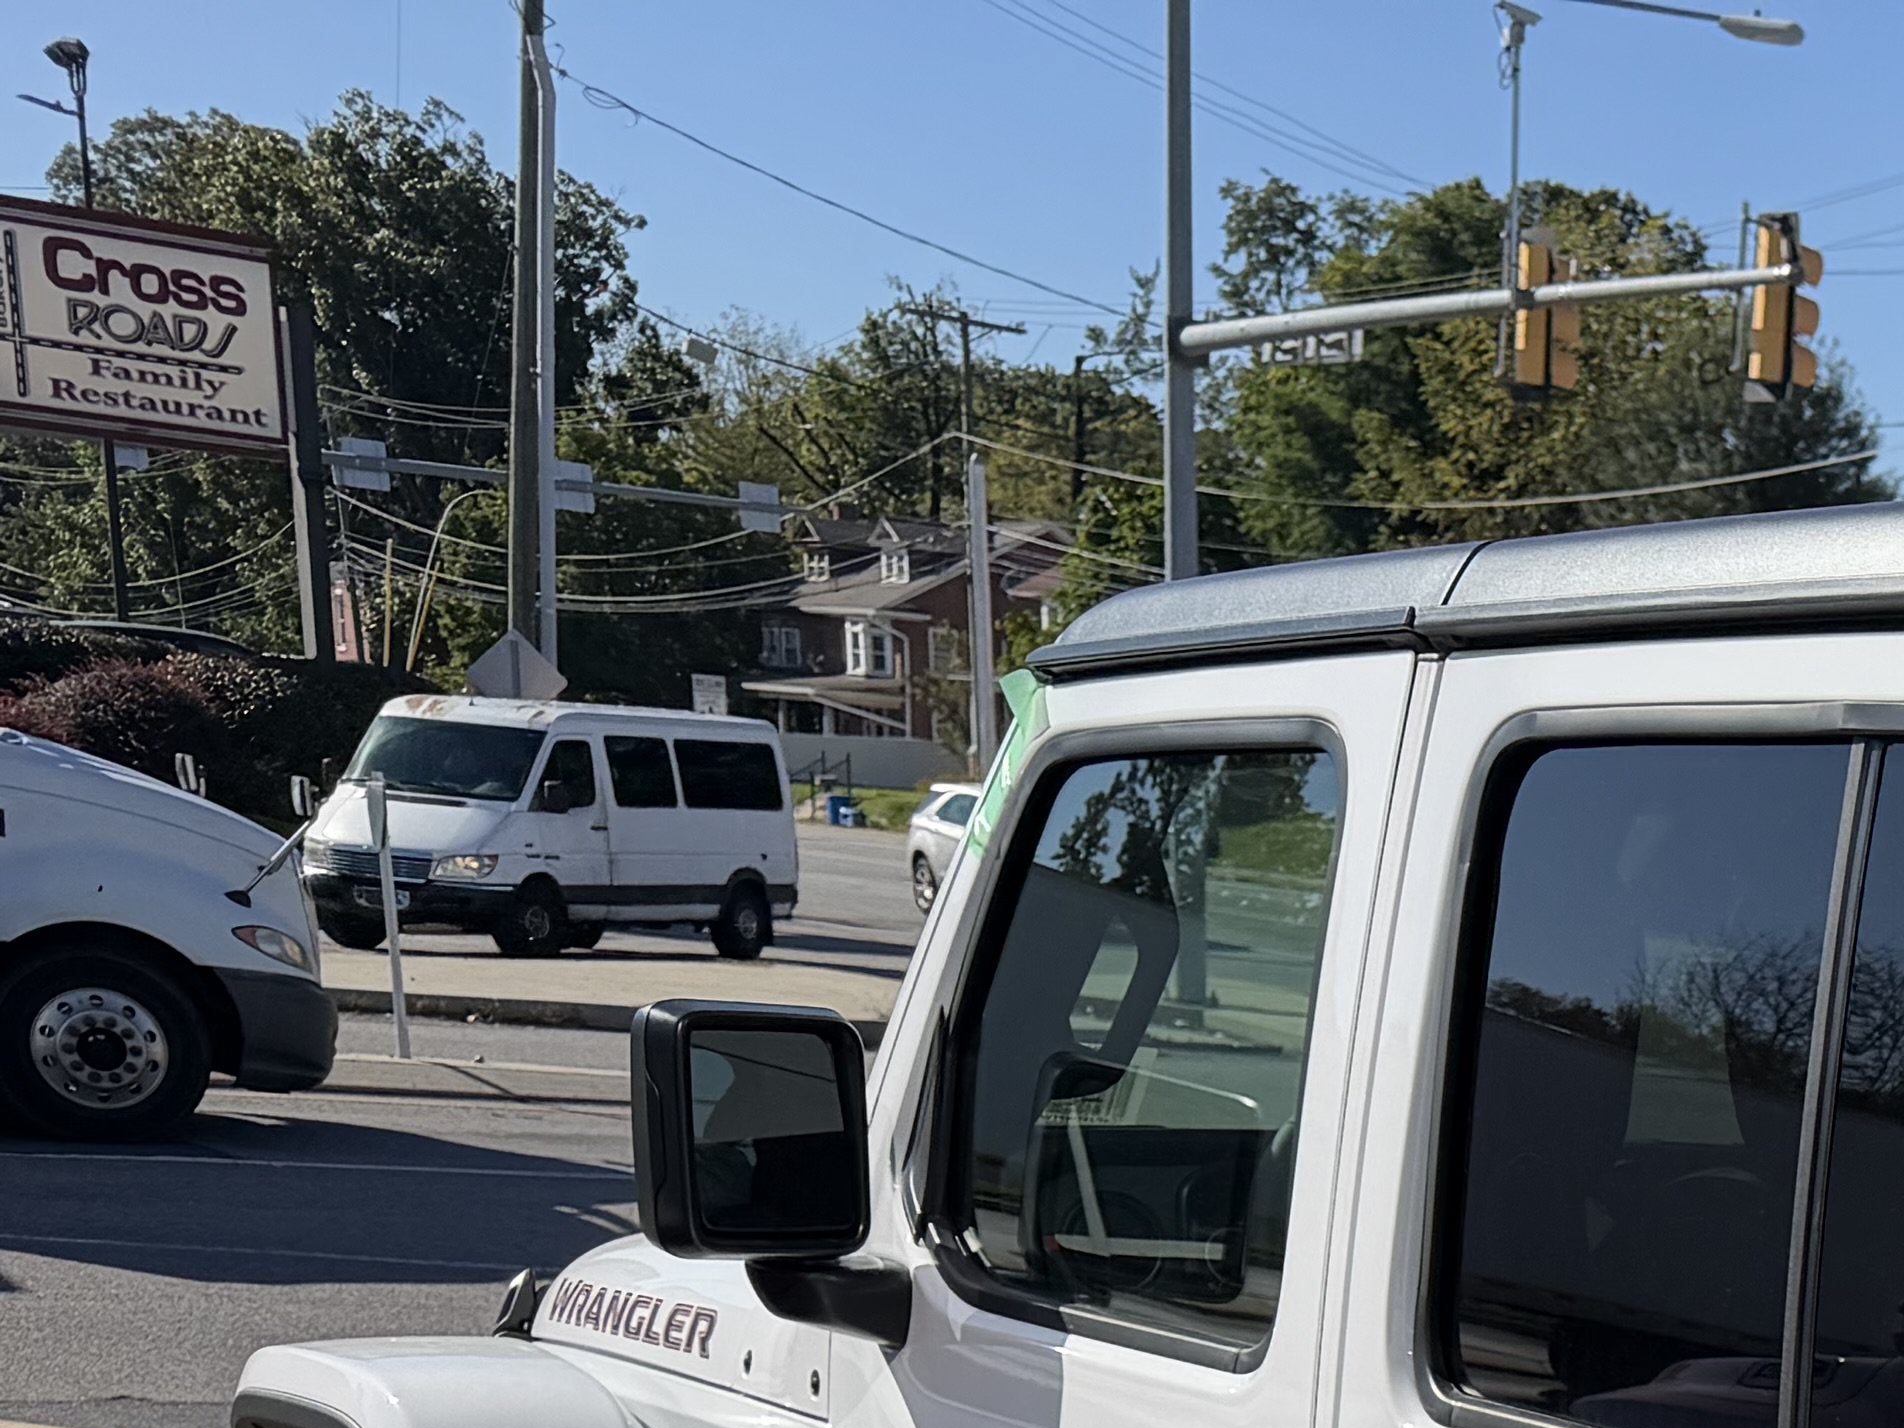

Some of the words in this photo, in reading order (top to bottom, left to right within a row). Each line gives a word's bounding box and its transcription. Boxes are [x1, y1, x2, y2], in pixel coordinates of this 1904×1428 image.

[43, 236, 247, 317] Cross
[48, 377, 269, 428] Restaurant
[89, 357, 227, 400] Family
[547, 1277, 718, 1360] WRANGLER
